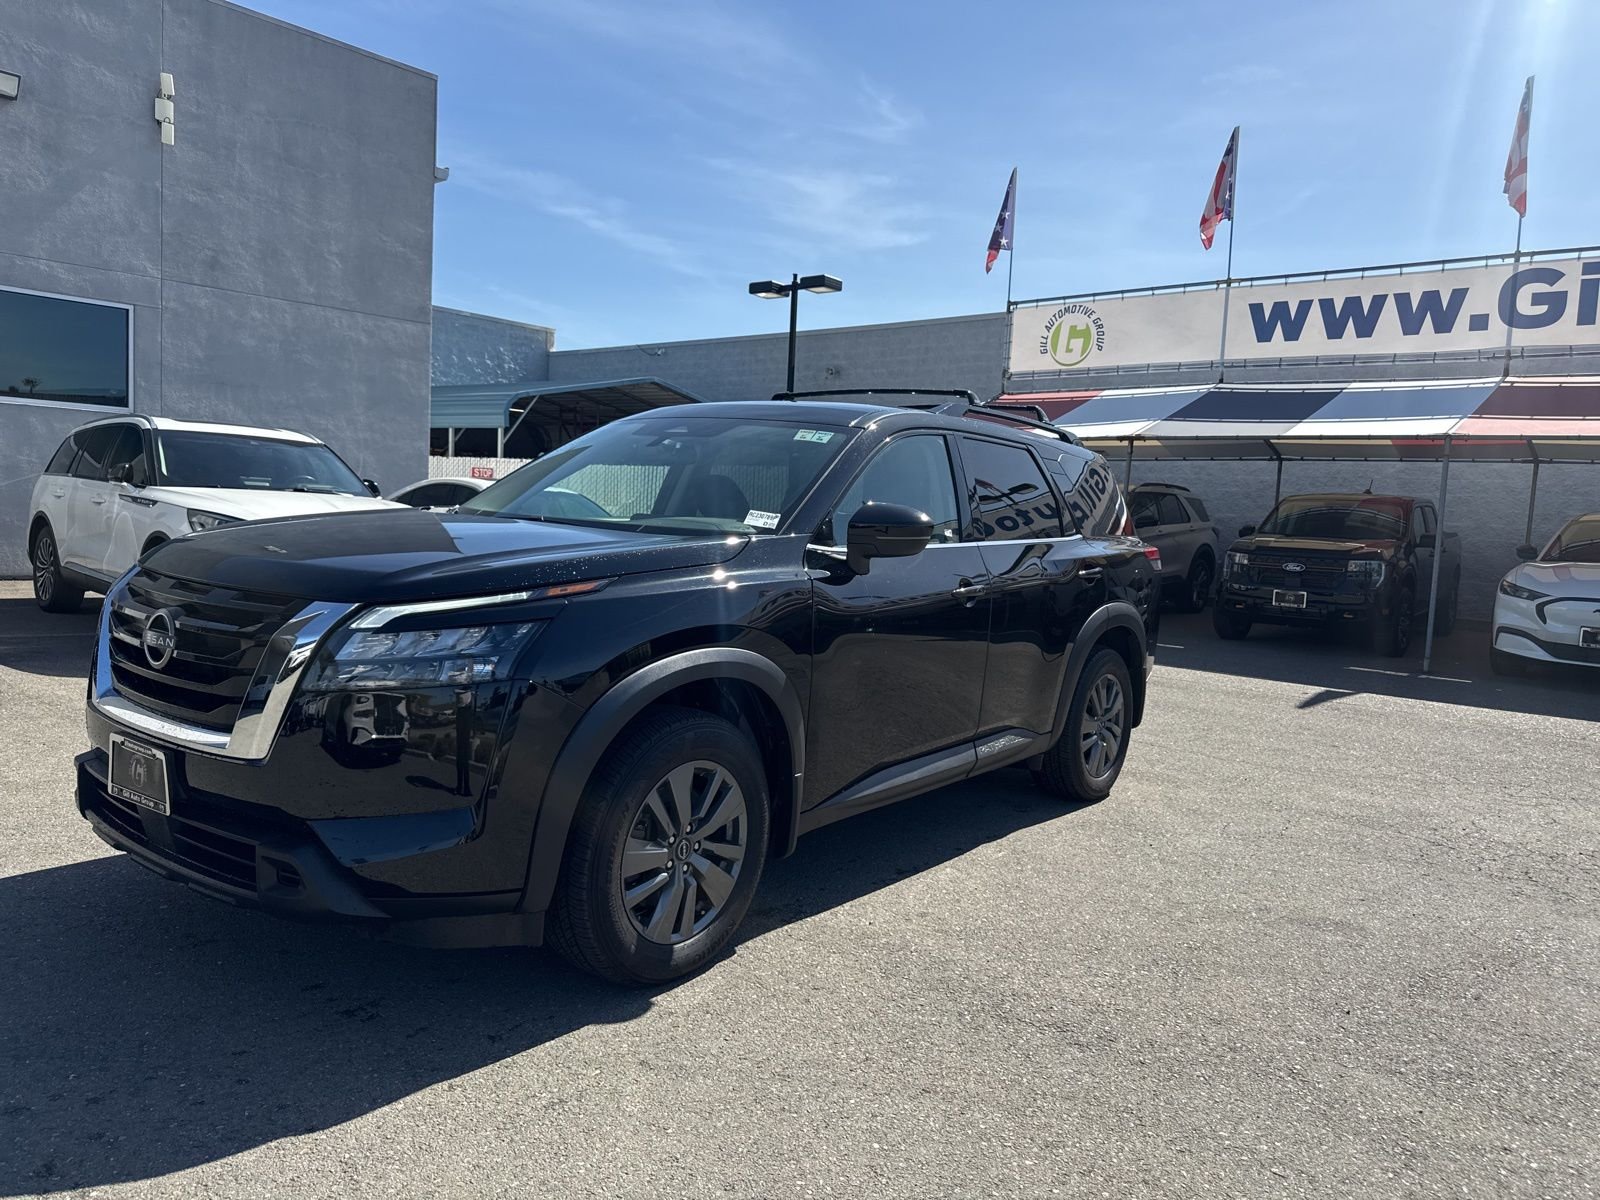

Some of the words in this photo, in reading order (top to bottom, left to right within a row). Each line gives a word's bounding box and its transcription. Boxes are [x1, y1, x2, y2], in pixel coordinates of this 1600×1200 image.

[1044, 304, 1096, 333] AUTOMOTIVE
[1092, 317, 1105, 352] GROUP
[1040, 335, 1049, 354] GILL
[473, 468, 493, 478] STOP
[146, 632, 174, 648] SAN
[979, 734, 1025, 754] PATHFI
